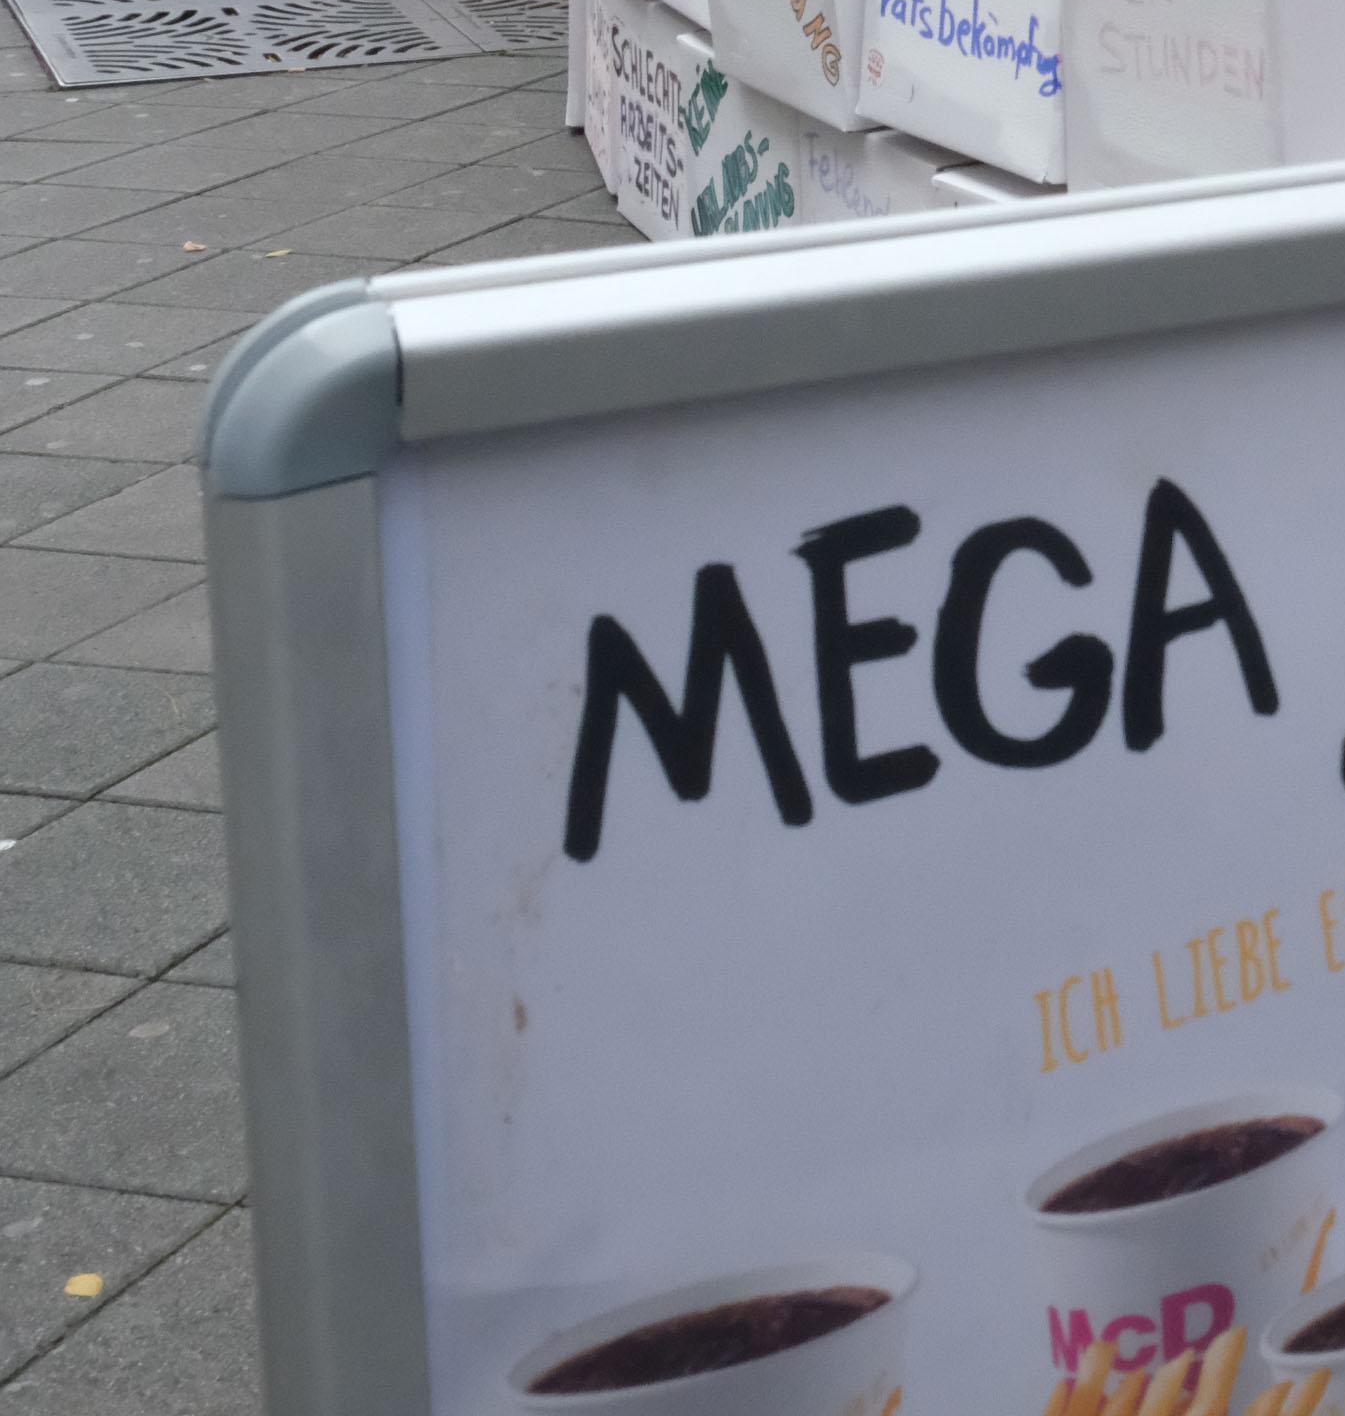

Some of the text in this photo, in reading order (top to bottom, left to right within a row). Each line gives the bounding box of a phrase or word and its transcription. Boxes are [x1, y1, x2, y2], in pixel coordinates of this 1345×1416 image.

[1099, 20, 1267, 101] STUNDEN
[620, 95, 685, 178] ARBEITS-
[634, 156, 680, 232] ZEITEN
[563, 476, 1280, 864] MEGA
[1034, 966, 1123, 1074] ICH
[1151, 908, 1293, 1031] LIEBE
